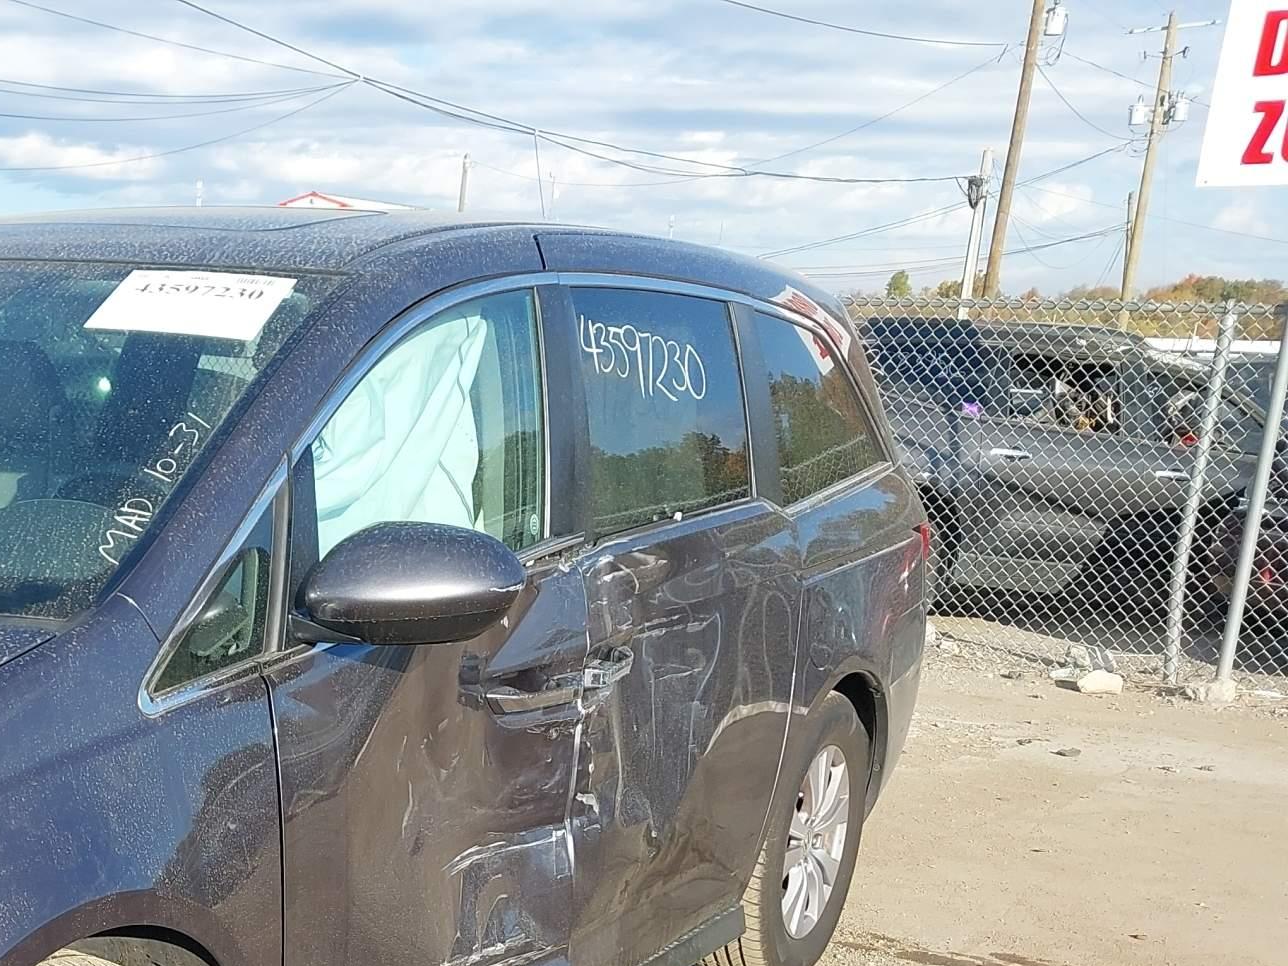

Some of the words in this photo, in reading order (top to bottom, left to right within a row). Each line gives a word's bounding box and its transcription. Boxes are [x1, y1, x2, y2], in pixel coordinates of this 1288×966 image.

[1240, 99, 1288, 165] Z
[580, 314, 706, 402] 43597230
[98, 497, 154, 565] MAD
[143, 411, 212, 483] 10-31
